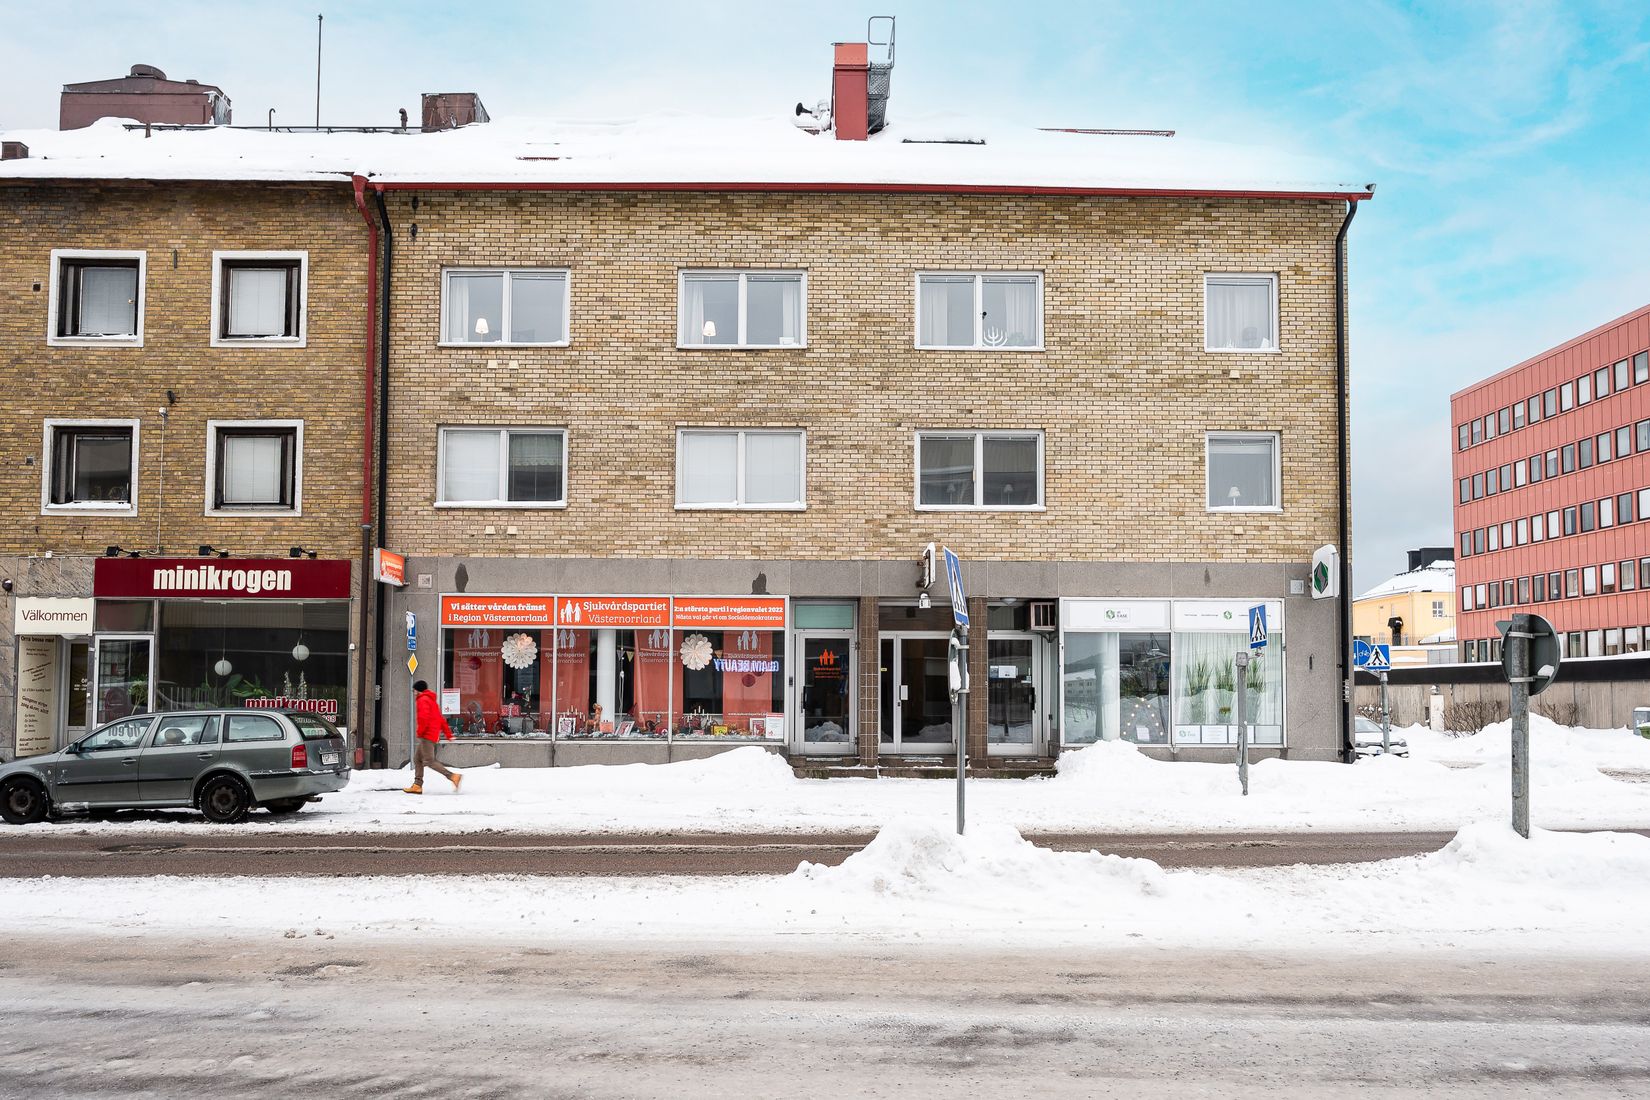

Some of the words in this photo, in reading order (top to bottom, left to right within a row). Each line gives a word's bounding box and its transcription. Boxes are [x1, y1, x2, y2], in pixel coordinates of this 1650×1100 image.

[153, 565, 292, 593] minikrogen
[450, 602, 460, 611] Vi
[460, 602, 487, 611] sätter
[487, 602, 517, 611] vården
[517, 602, 547, 611] främst
[583, 601, 667, 612] Sjukvårdspartiet
[684, 605, 709, 613] största
[729, 606, 768, 614] regionvalet
[21, 608, 88, 622] Välkommen
[448, 613, 452, 622] i
[453, 613, 482, 623] Region
[483, 613, 548, 622] Västernorrland
[588, 614, 662, 624] Västernorrland
[245, 696, 338, 714] minikrogen
